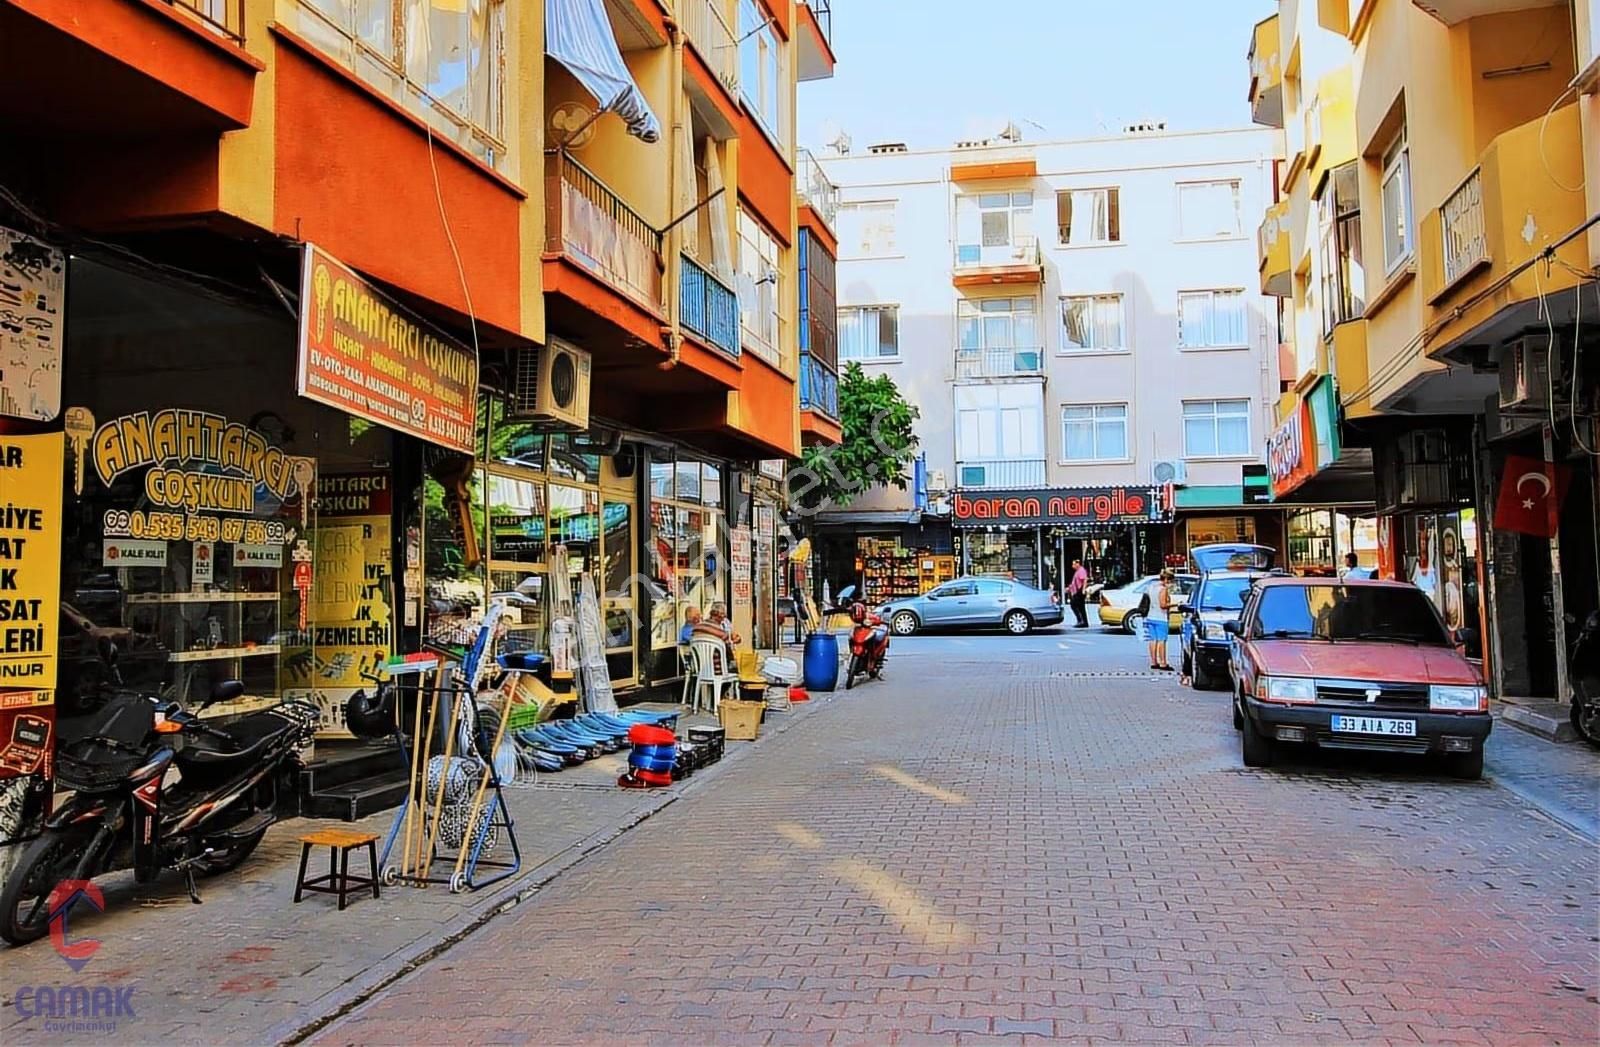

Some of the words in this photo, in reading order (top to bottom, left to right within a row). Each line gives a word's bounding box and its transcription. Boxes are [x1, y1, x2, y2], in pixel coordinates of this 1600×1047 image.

[333, 278, 419, 360] ANAHTARCI
[424, 334, 467, 386] COŞKUN
[92, 408, 292, 500] ANAHTARCI
[146, 467, 255, 516] COŞKUN
[954, 492, 1041, 520] baran
[1048, 488, 1145, 522] nargile
[185, 515, 221, 543] 543
[221, 518, 244, 544] 87
[0, 663, 44, 678] NUR
[1341, 717, 1355, 731] 33
[1389, 720, 1412, 735] 269
